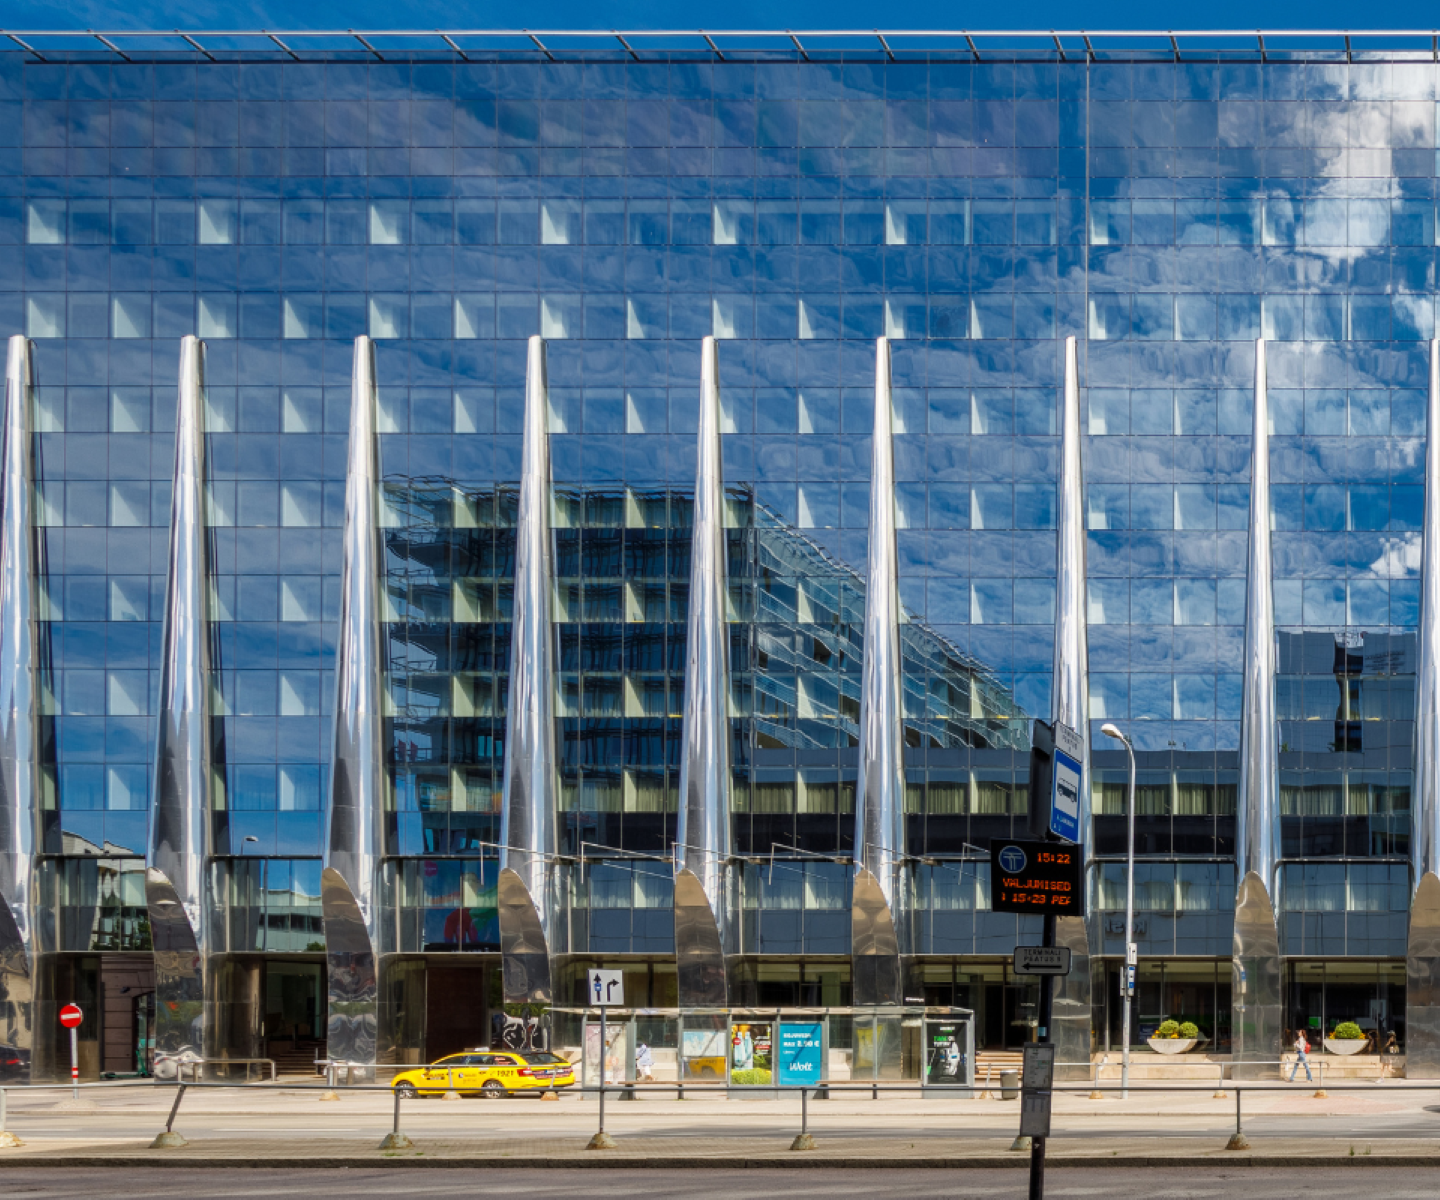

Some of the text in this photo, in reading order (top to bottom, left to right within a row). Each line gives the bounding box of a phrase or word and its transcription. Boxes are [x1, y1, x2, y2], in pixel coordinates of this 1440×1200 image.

[1036, 852, 1072, 865] 15:22
[1012, 893, 1047, 905] 15:23
[789, 1061, 814, 1072] Wolt
